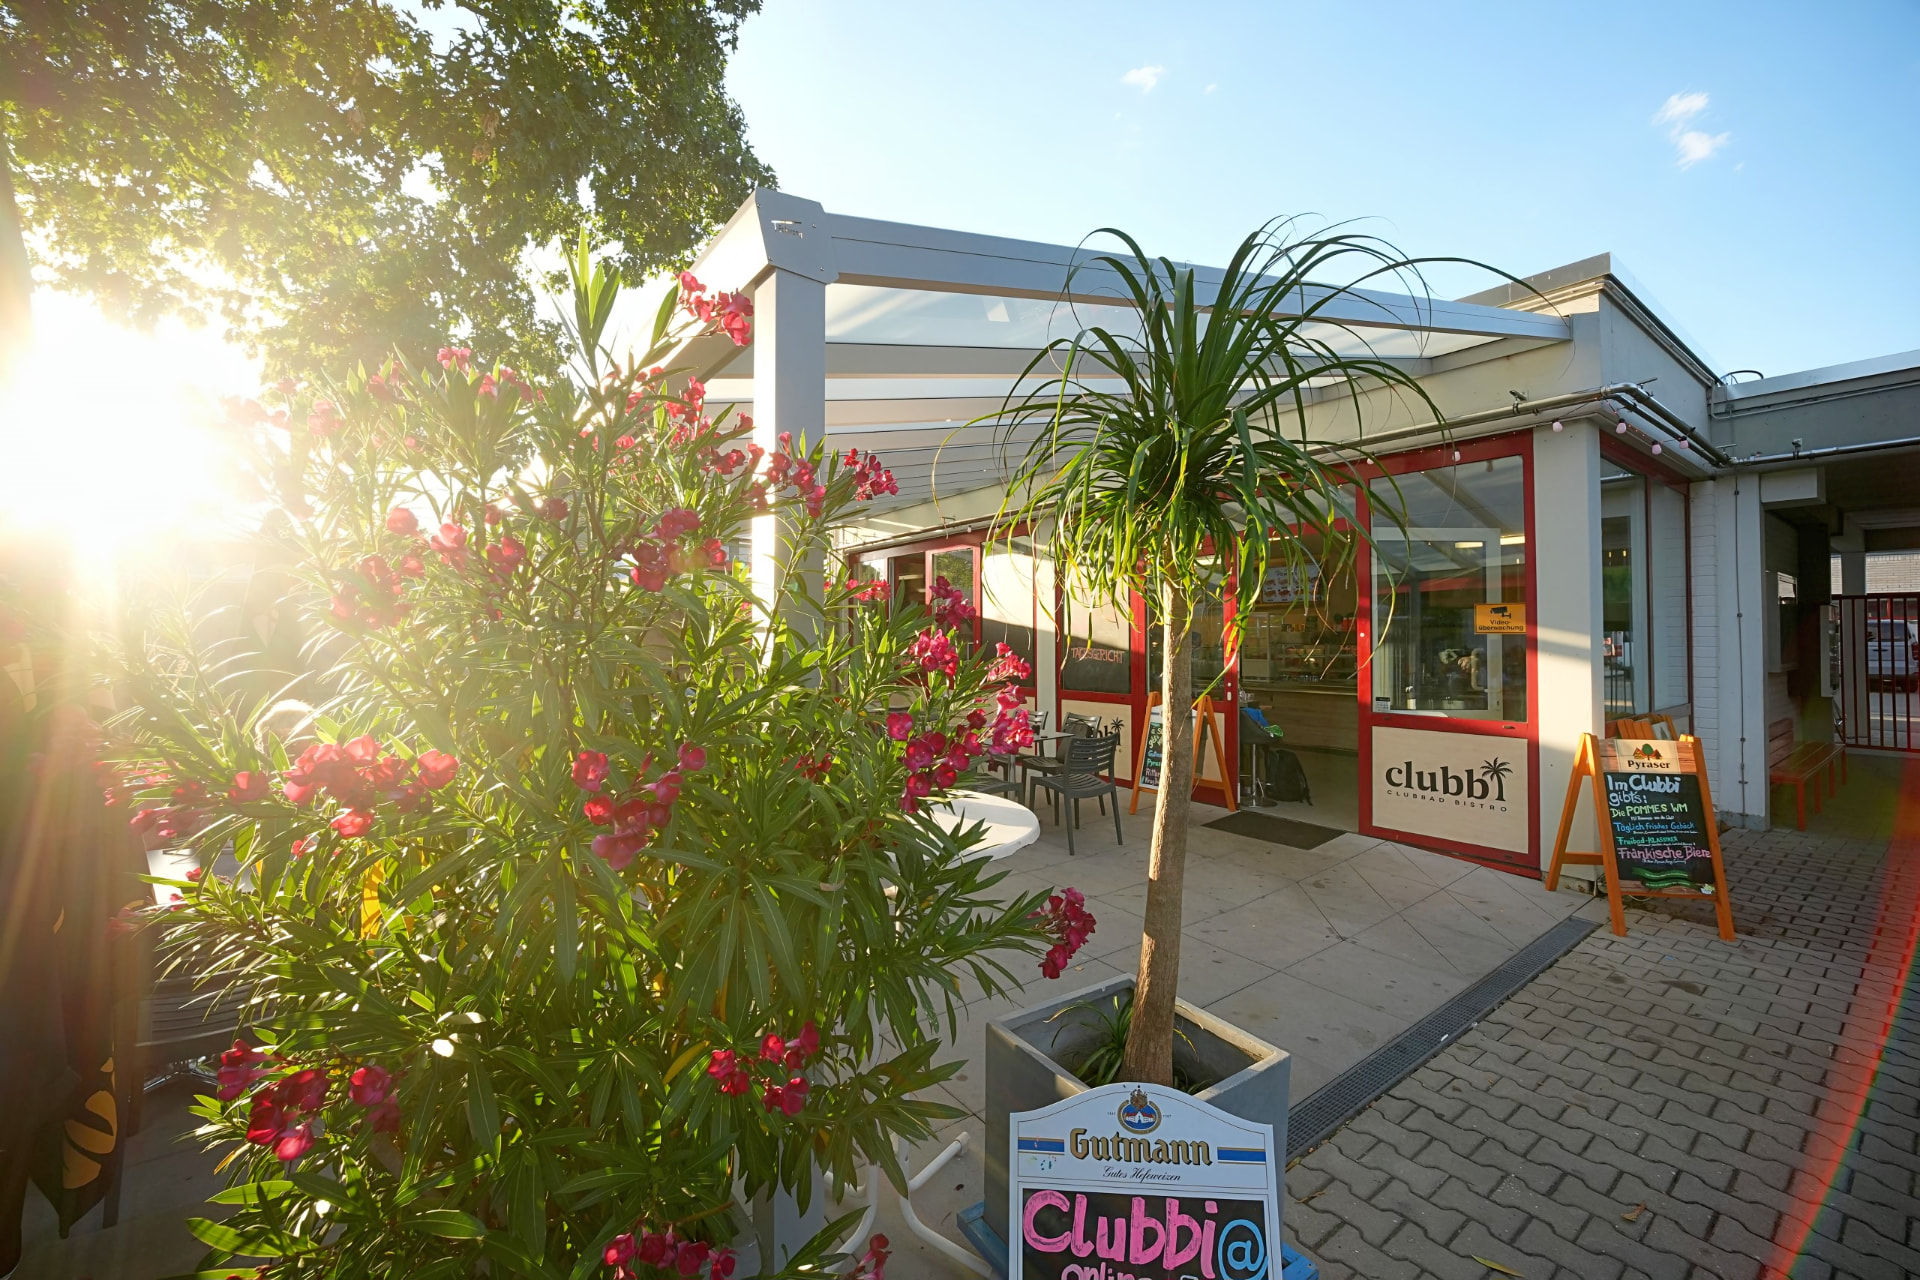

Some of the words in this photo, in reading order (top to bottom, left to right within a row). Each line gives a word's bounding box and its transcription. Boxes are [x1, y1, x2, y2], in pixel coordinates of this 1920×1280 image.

[1627, 759, 1670, 769] Pyraser
[1385, 757, 1513, 802] clubbi
[1607, 774, 1628, 791] Im
[1628, 774, 1681, 793] Clubbi
[1387, 789, 1445, 803] CLUBBAD
[1455, 799, 1507, 812] BISTRO
[1610, 808, 1625, 818] Die
[1626, 804, 1667, 816] POMMES
[1670, 803, 1688, 812] WM
[1617, 846, 1684, 859] Fränkische
[1683, 845, 1712, 860] Biere
[1069, 1127, 1213, 1166] Gutmann
[1103, 1165, 1128, 1178] Gutes
[1130, 1167, 1181, 1183] Hefeweizen
[1061, 1262, 1153, 1280] onli
